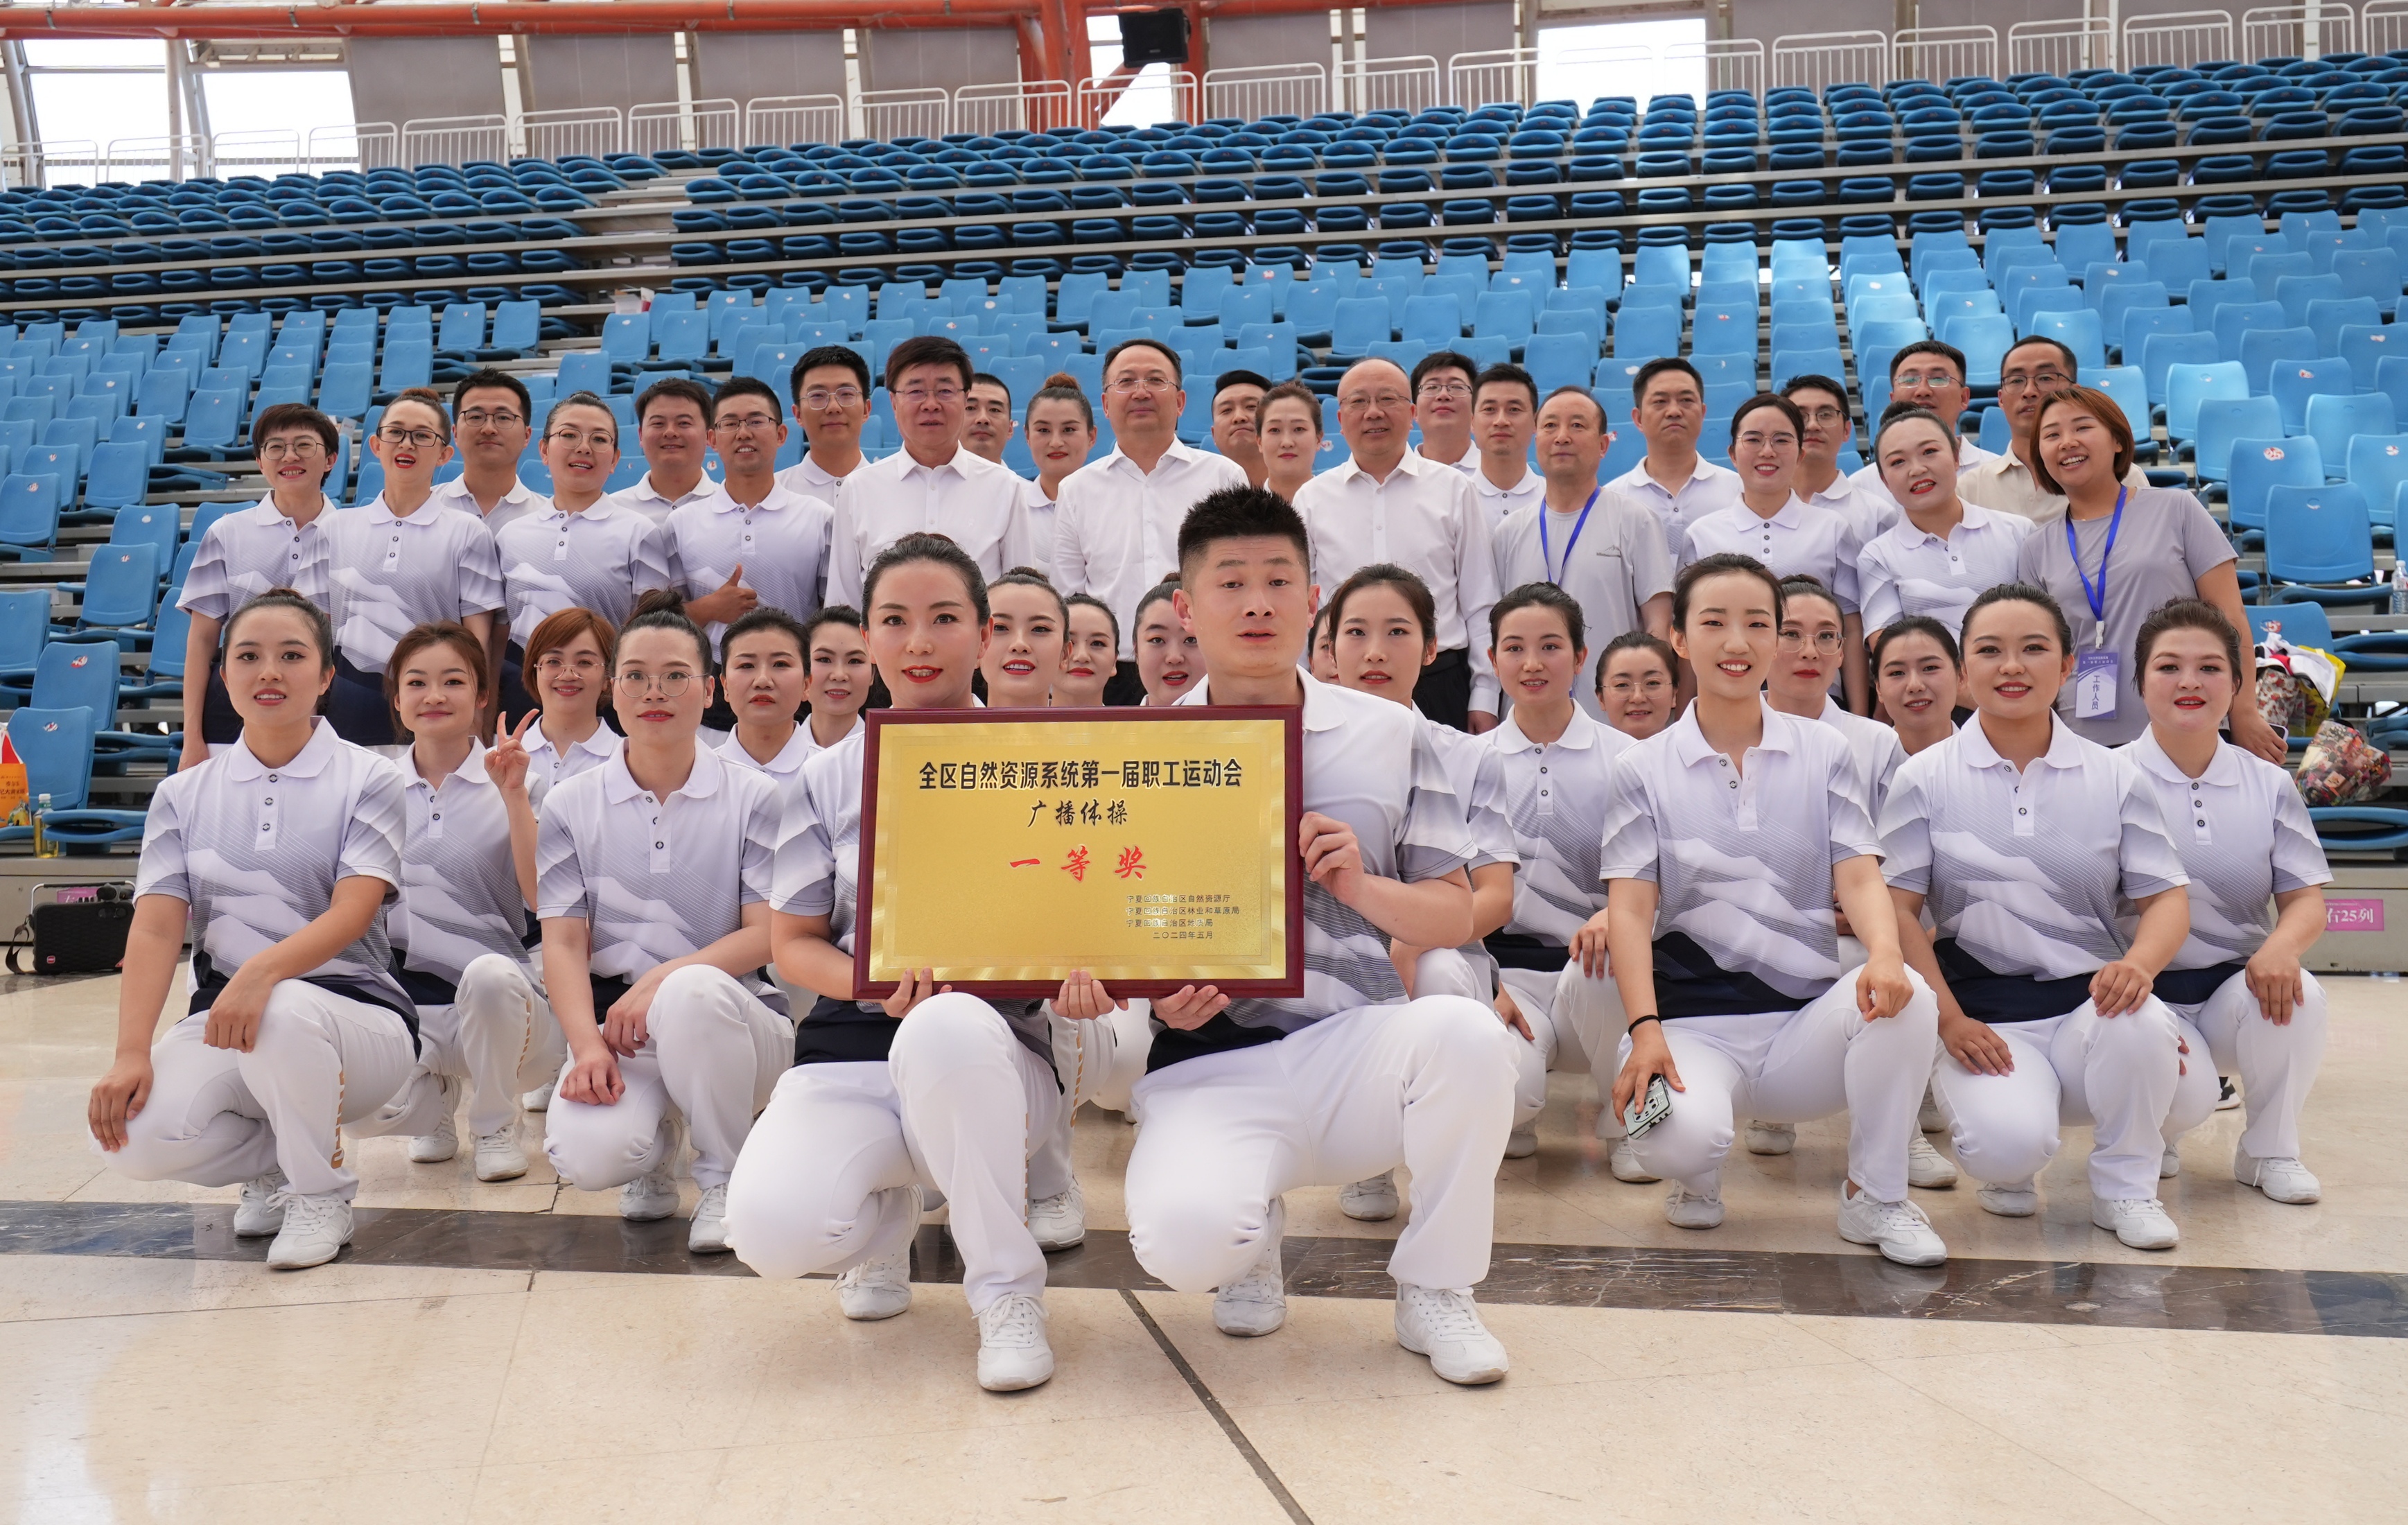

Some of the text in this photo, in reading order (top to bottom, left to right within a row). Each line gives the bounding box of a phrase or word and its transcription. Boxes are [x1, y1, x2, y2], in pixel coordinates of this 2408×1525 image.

[2091, 675, 2100, 710] 工作人员
[919, 758, 1241, 789] 全区自然资源系统第一届职工运动会
[1027, 799, 1128, 827] 广播体操
[1009, 845, 1146, 881] 一等奖
[1126, 894, 1230, 903] 宁夏回族自治区自然资源厅
[1126, 906, 1239, 916] 宁夏回族自治区林业和草原局
[1126, 918, 1213, 927] 宁夏回族自治区地质局
